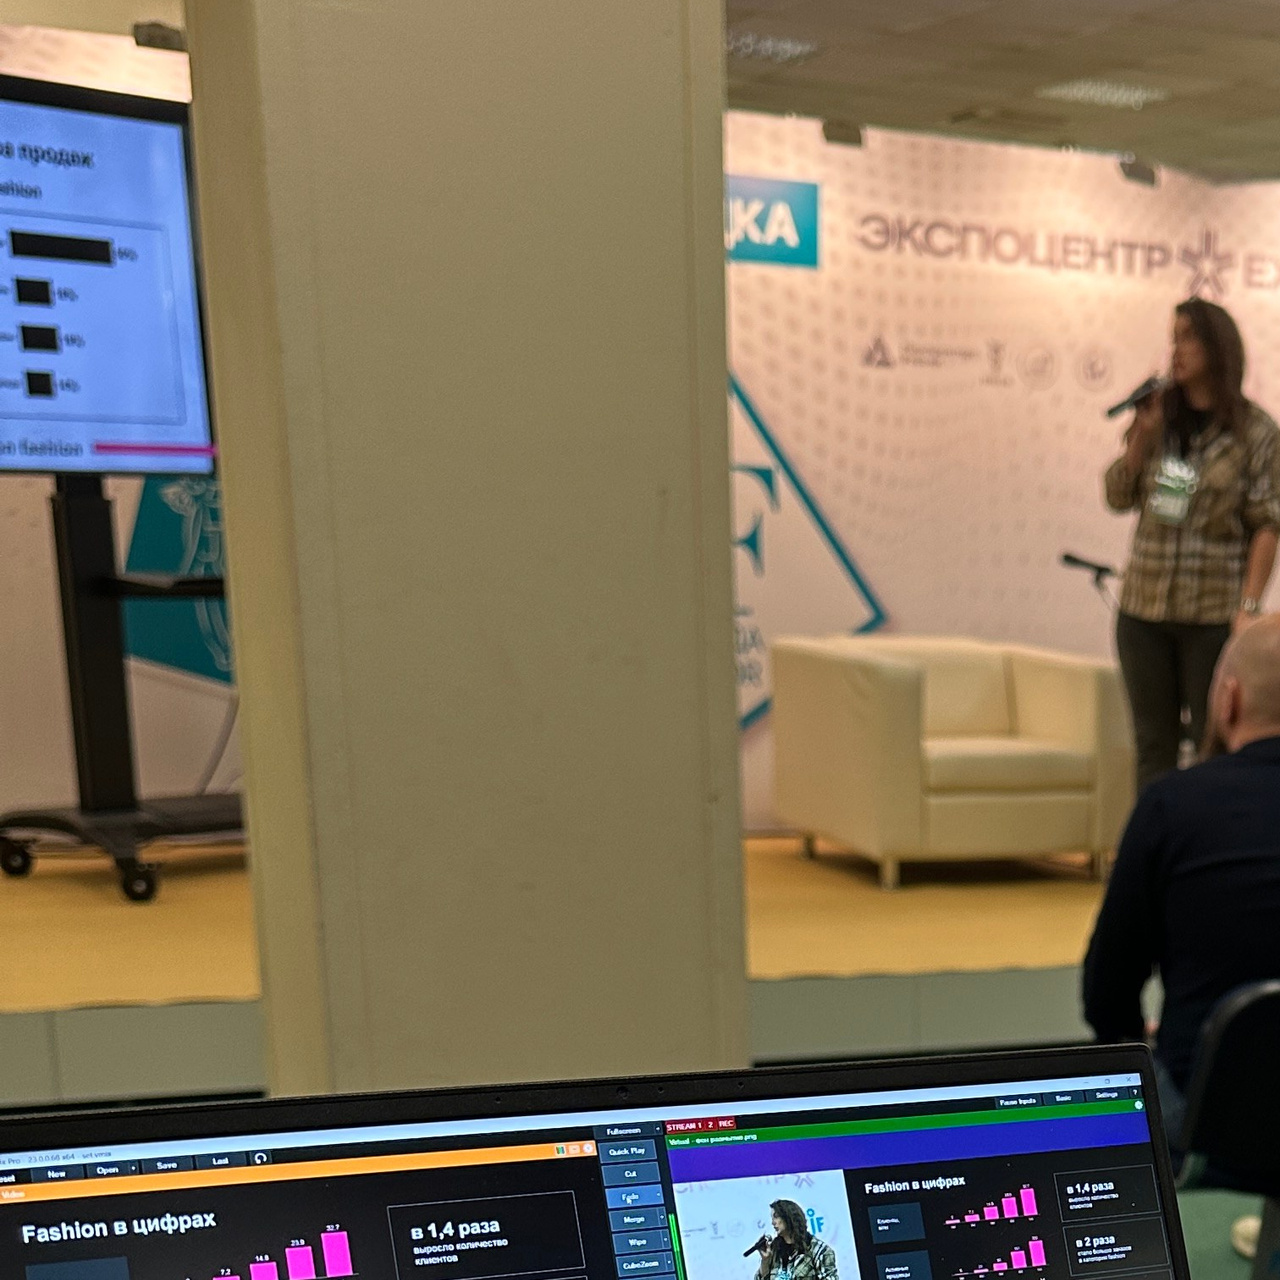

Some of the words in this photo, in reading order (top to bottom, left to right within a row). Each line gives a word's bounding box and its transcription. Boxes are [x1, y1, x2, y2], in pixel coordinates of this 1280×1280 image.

[727, 198, 799, 250] КА
[859, 213, 1171, 276] ЭКСПОЦЕНТР
[666, 1123, 696, 1131] STREAM
[96, 1166, 119, 1175] Open
[156, 1160, 178, 1170] Save
[48, 1170, 66, 1178] New
[864, 1182, 912, 1194] Fashion
[922, 1176, 966, 1190] цифрах
[22, 1220, 108, 1243] Fashion
[114, 1220, 129, 1235] в
[133, 1211, 216, 1236] цифрах
[410, 1228, 424, 1240] в
[427, 1222, 454, 1241] 1,4
[458, 1220, 500, 1240] раза
[414, 1243, 454, 1255] выросло
[456, 1238, 508, 1250] количество
[415, 1254, 458, 1266] клиентов
